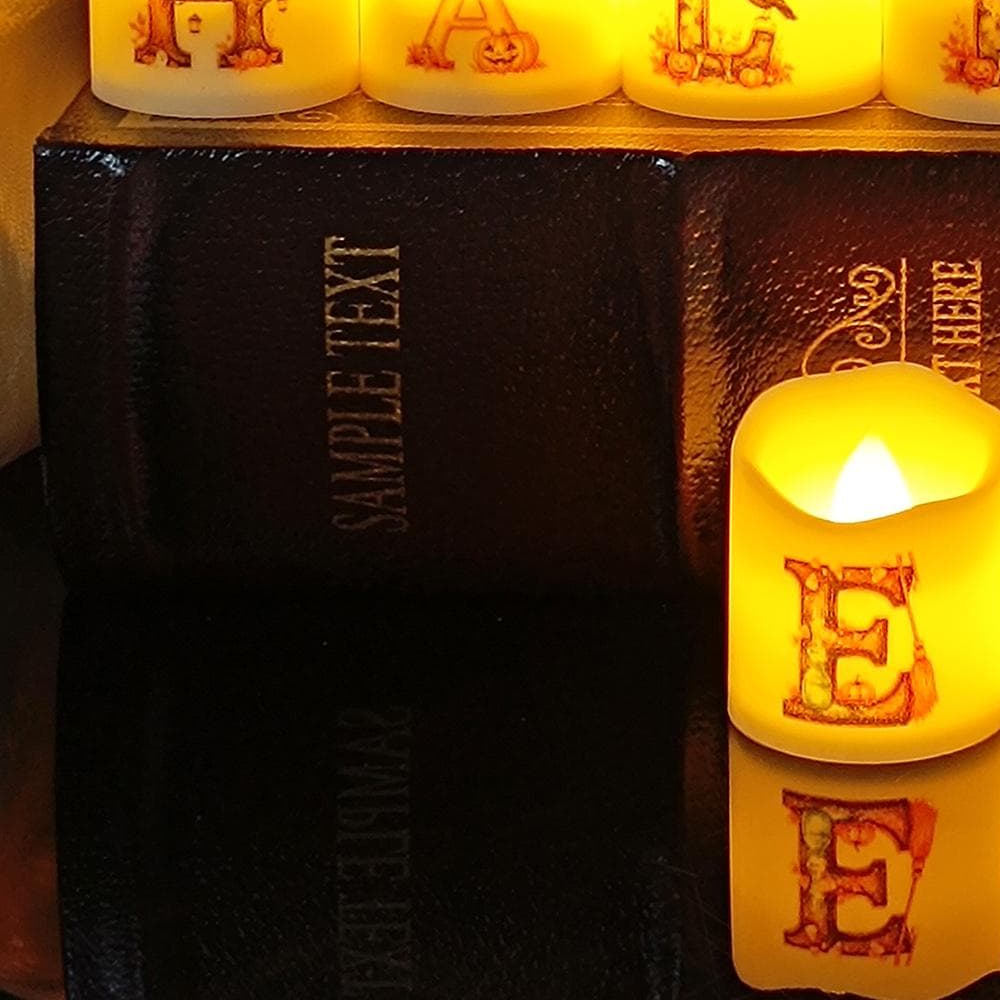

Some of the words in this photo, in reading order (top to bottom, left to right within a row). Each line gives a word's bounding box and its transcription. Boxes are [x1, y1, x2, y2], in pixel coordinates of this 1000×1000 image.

[324, 233, 401, 357] TEXT
[931, 259, 983, 346] HERE
[326, 369, 410, 533] SAMPLE
